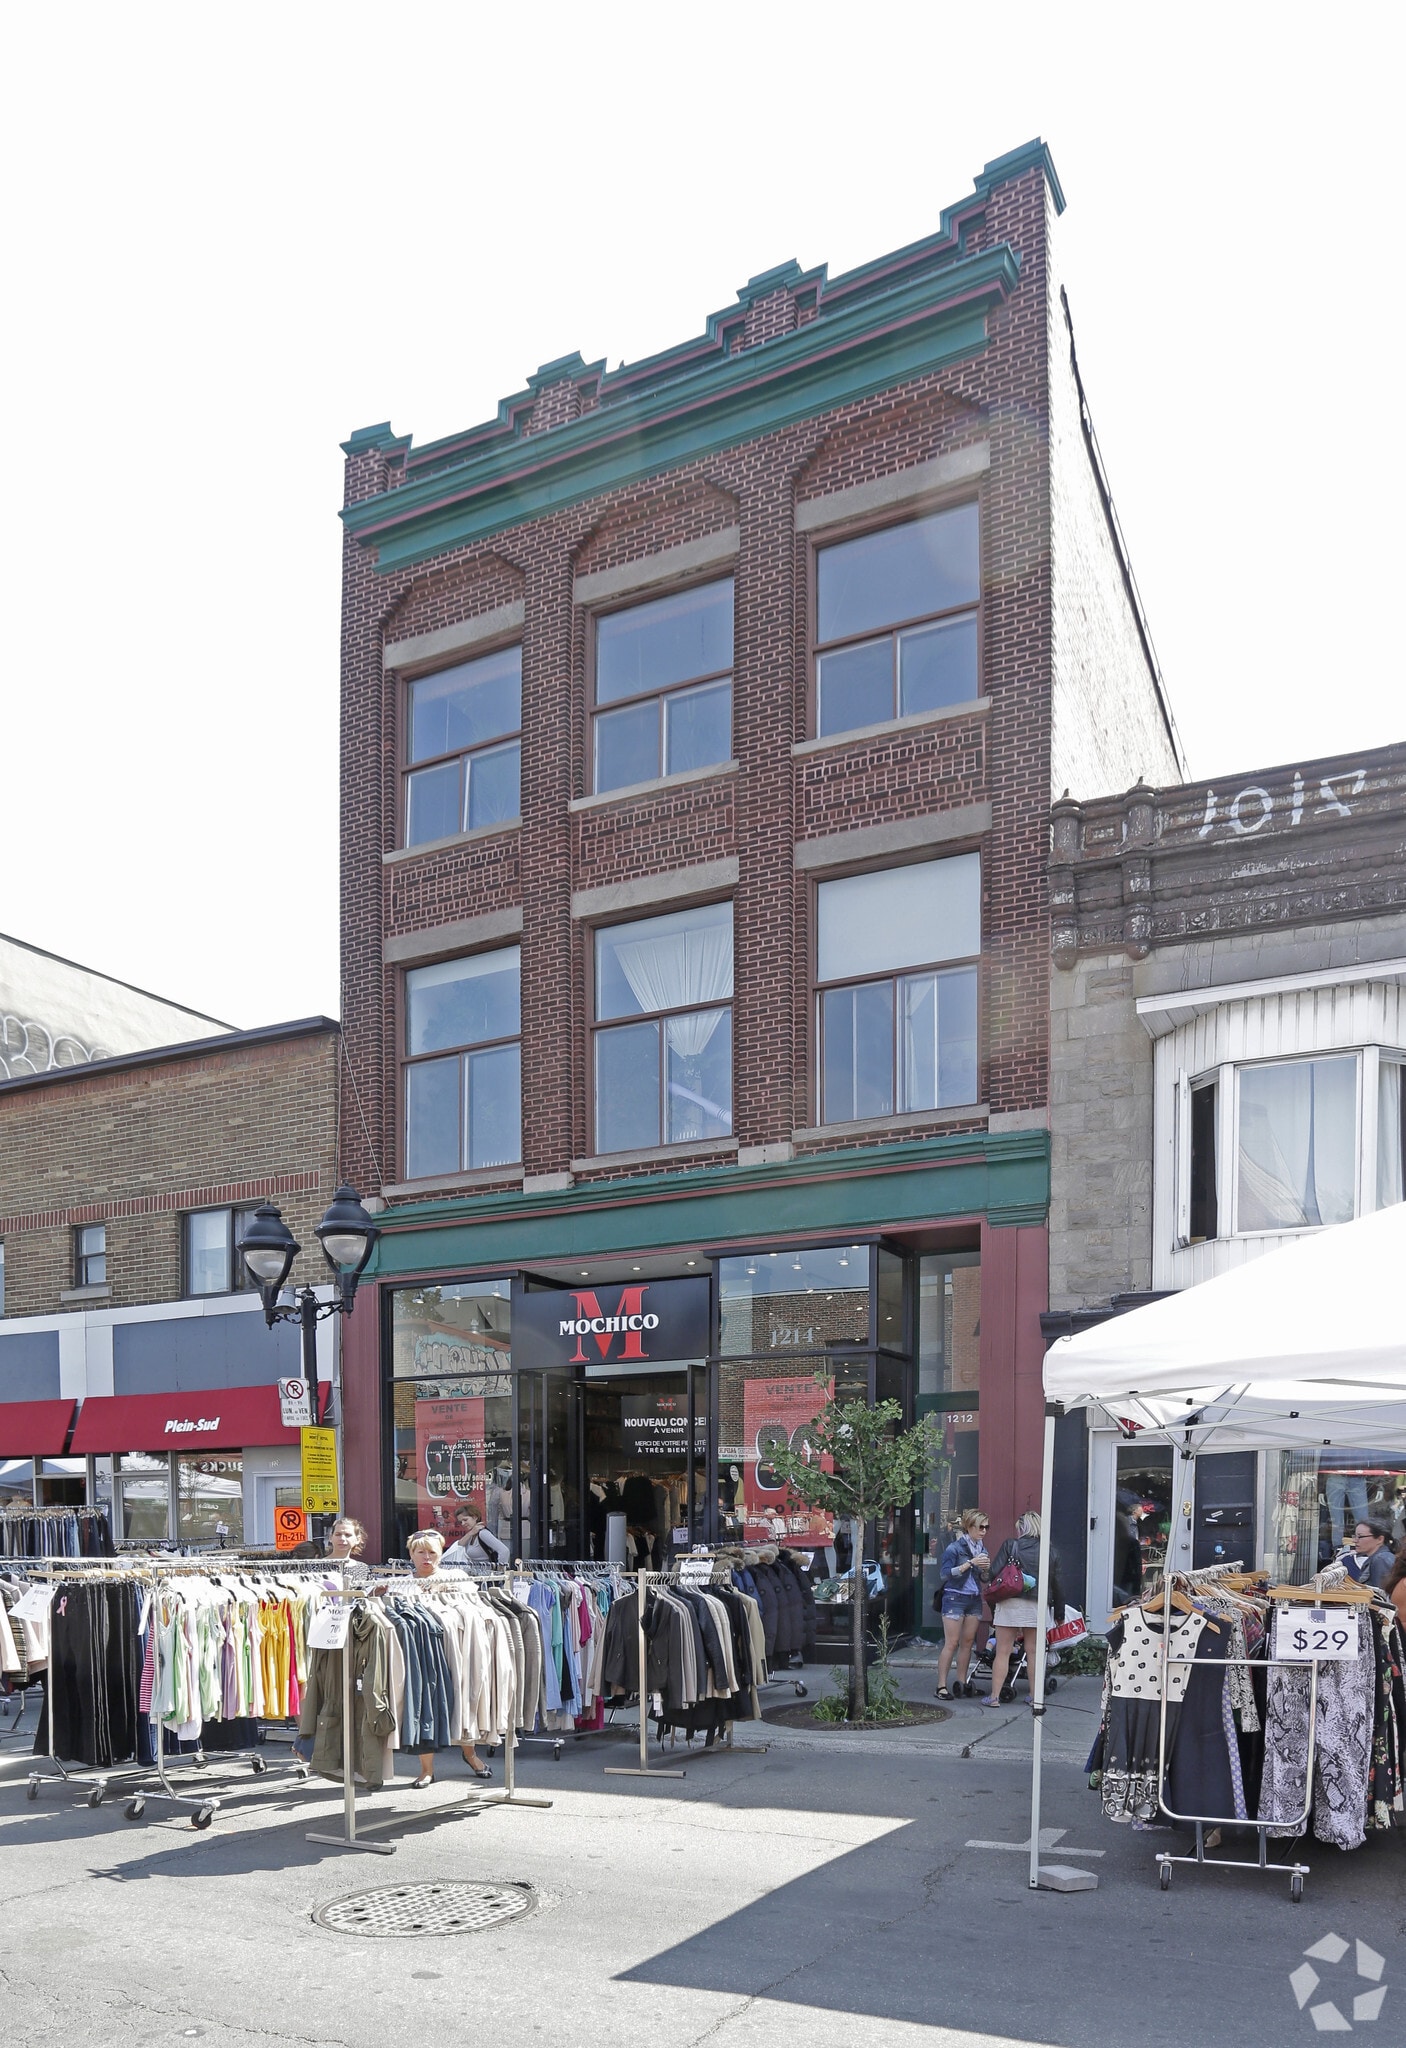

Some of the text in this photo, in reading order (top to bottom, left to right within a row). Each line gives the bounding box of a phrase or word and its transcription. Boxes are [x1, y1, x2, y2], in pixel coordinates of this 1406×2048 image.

[558, 1313, 660, 1336] MOCHICO
[770, 1327, 814, 1345] 1214
[764, 1383, 813, 1395] VENTE
[431, 1403, 468, 1414] VENTE
[624, 1417, 668, 1428] NOUVEAU
[946, 1414, 973, 1423] 1212
[164, 1417, 221, 1433] Plein-Sud
[277, 1532, 305, 1541] 7h-21h
[1292, 1627, 1349, 1653] $29
